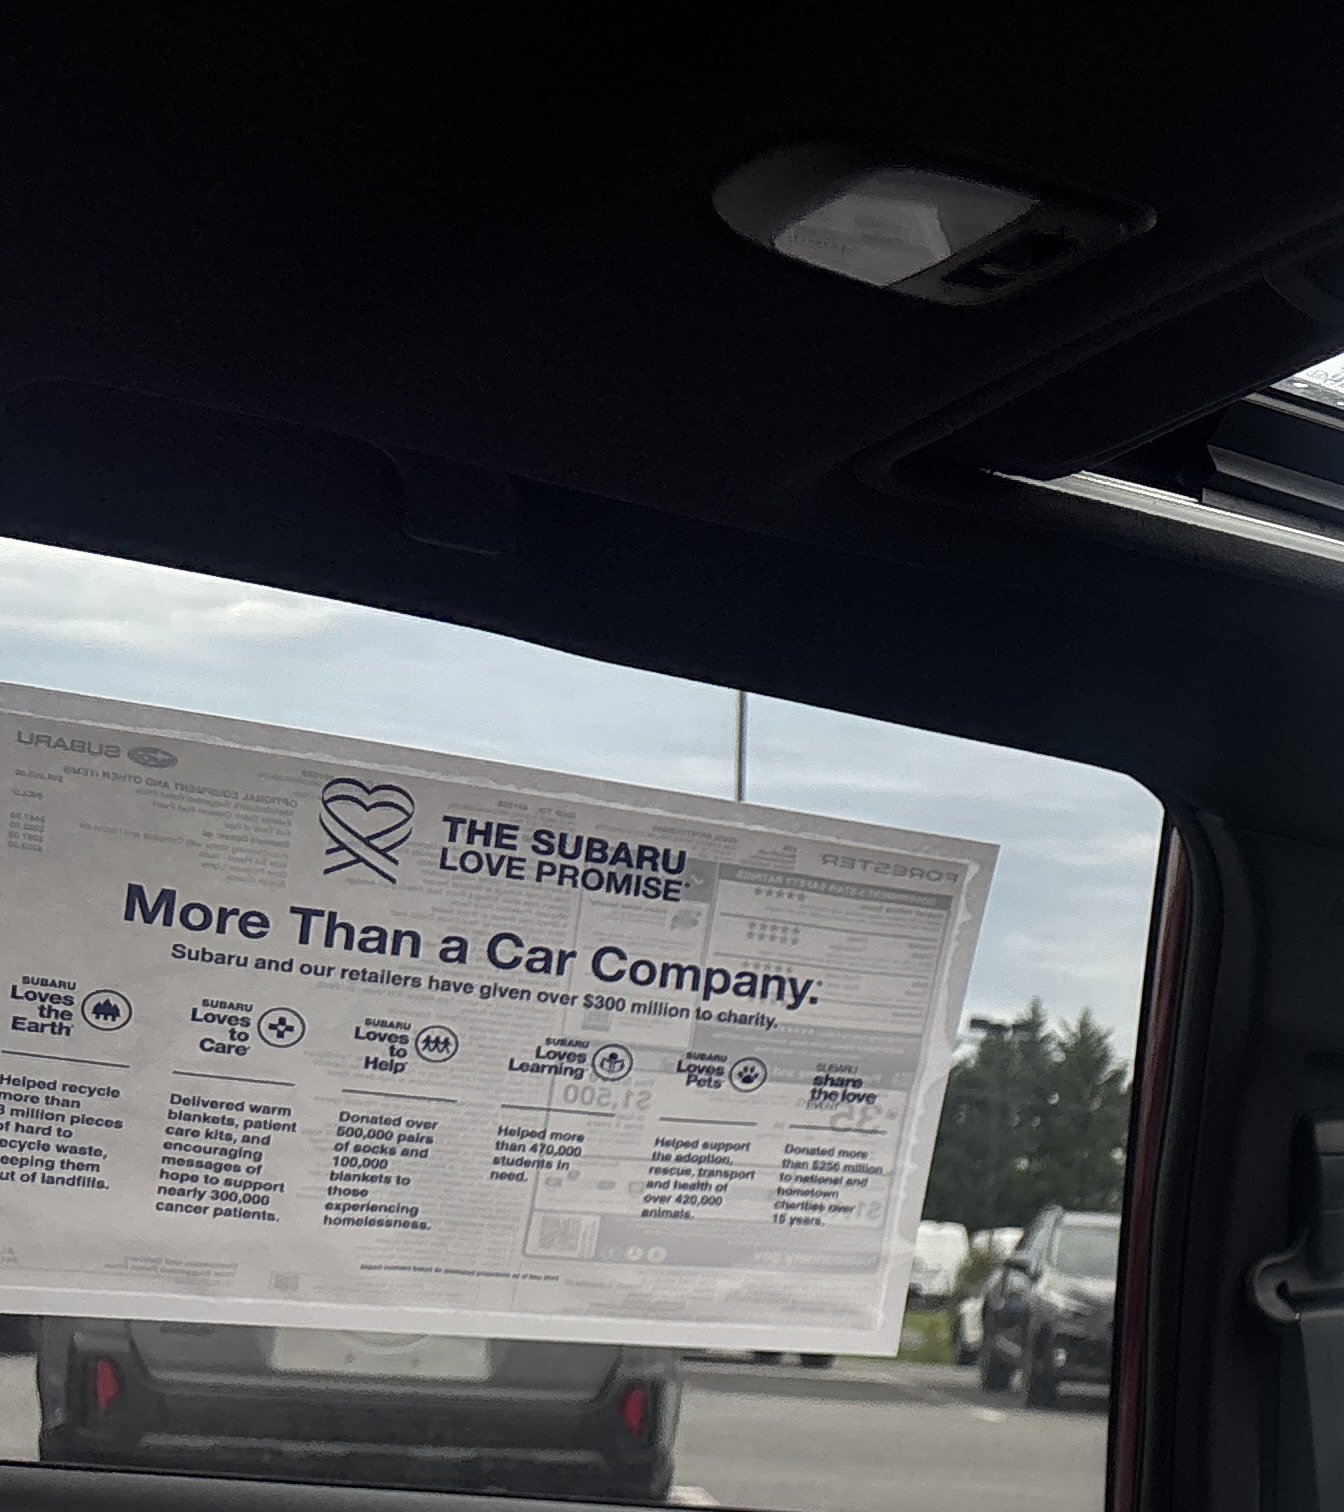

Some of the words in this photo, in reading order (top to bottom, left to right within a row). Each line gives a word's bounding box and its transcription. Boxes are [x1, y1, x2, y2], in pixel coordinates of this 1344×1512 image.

[441, 815, 520, 851] THE
[531, 828, 687, 875] SUBARU
[438, 847, 525, 880] LOVE
[535, 860, 686, 902] PROMISE
[123, 882, 271, 940] More
[289, 905, 422, 959] Than
[438, 934, 468, 965] a
[486, 932, 578, 977] Car
[591, 945, 816, 1011] Company.
[22, 975, 76, 991] SUBARU
[171, 943, 249, 968] Subaru
[254, 957, 294, 973] and
[299, 962, 336, 978] our
[340, 966, 422, 990] retailers
[428, 974, 474, 995] have
[479, 981, 532, 1003] given
[536, 989, 582, 1008] over
[583, 992, 627, 1013] $300
[631, 1000, 691, 1019] million
[696, 1006, 713, 1021] to
[717, 1010, 779, 1031] charity.
[10, 985, 75, 1006] Loves
[38, 1005, 73, 1020] the
[201, 999, 253, 1012] SUBARU
[11, 1016, 72, 1036] Earth
[191, 1008, 250, 1027] Loves
[364, 1018, 412, 1030] SUBARU
[229, 1027, 249, 1042] to
[354, 1027, 410, 1044] Loves
[545, 1037, 590, 1049] SUBARU
[199, 1038, 248, 1056] Care
[389, 1045, 408, 1058] to
[535, 1046, 587, 1064] Loves
[364, 1056, 406, 1075] Help
[686, 1052, 728, 1063] SUBARU
[508, 1057, 586, 1081] Learning
[676, 1060, 725, 1077] Loves
[1, 1074, 57, 1091] Helped
[62, 1083, 121, 1098] recycle
[685, 1074, 722, 1090] Pets
[813, 1073, 863, 1089] share
[0, 1092, 40, 1105] more
[45, 1094, 81, 1109] than
[810, 1086, 838, 1102] the
[840, 1090, 877, 1105] love
[170, 1093, 245, 1112] Delivered
[249, 1104, 292, 1117] warm
[10, 1107, 65, 1123] million
[70, 1114, 123, 1129] pieces
[167, 1109, 239, 1128] blankets,
[243, 1118, 297, 1133] patient
[338, 1111, 402, 1127] Donated
[405, 1118, 438, 1131] over
[15, 1122, 52, 1136] hard
[57, 1127, 73, 1138] to
[165, 1126, 200, 1138] care
[205, 1129, 237, 1145] kits,
[241, 1133, 271, 1146] and
[336, 1126, 394, 1141] 500,000
[397, 1131, 434, 1146] pairs
[497, 1125, 547, 1141] Helped
[550, 1131, 585, 1143] more
[0, 1137, 51, 1152] ecycle
[56, 1143, 107, 1160] waste,
[163, 1140, 263, 1162] encouraging
[334, 1141, 351, 1153] of
[353, 1143, 397, 1155] socks
[400, 1146, 429, 1159] and
[495, 1140, 526, 1153] than
[529, 1142, 582, 1157] 470,000
[654, 1136, 699, 1151] Helped
[702, 1140, 751, 1153] support
[784, 1143, 834, 1157] Donated
[838, 1149, 869, 1160] more
[0, 1155, 55, 1171] eeping
[60, 1160, 100, 1173] them
[161, 1155, 242, 1175] messages
[245, 1164, 262, 1175] of
[333, 1155, 388, 1170] 100,000
[492, 1155, 553, 1169] students
[556, 1160, 570, 1171] in
[651, 1151, 672, 1163] the
[675, 1152, 733, 1167] adoption,
[782, 1157, 808, 1170] than
[843, 1162, 883, 1175] million
[0, 1170, 16, 1181] ut
[20, 1172, 37, 1183] of
[41, 1173, 110, 1190] landfills.
[159, 1169, 199, 1185] hope
[203, 1174, 220, 1186] to
[224, 1178, 285, 1194] support
[329, 1170, 392, 1186] blankets
[396, 1174, 411, 1187] to
[490, 1170, 528, 1182] need.
[649, 1166, 696, 1179] rescue,
[698, 1167, 755, 1182] transport
[779, 1172, 792, 1183] to
[795, 1173, 843, 1186] national
[846, 1176, 868, 1188] and
[327, 1185, 369, 1198] those
[646, 1179, 670, 1190] and
[673, 1180, 712, 1192] health
[715, 1182, 728, 1193] of
[776, 1186, 839, 1199] hometown
[157, 1185, 206, 1202] nearly
[210, 1188, 270, 1206] 300,000
[643, 1194, 672, 1205] over
[155, 1202, 209, 1215] cancer
[213, 1207, 280, 1222] patients.
[324, 1200, 420, 1218] experiencing
[641, 1208, 695, 1220] animals.
[773, 1200, 826, 1213] charities
[828, 1203, 856, 1213] over
[323, 1214, 432, 1231] homelessness.
[789, 1214, 825, 1228] years.
